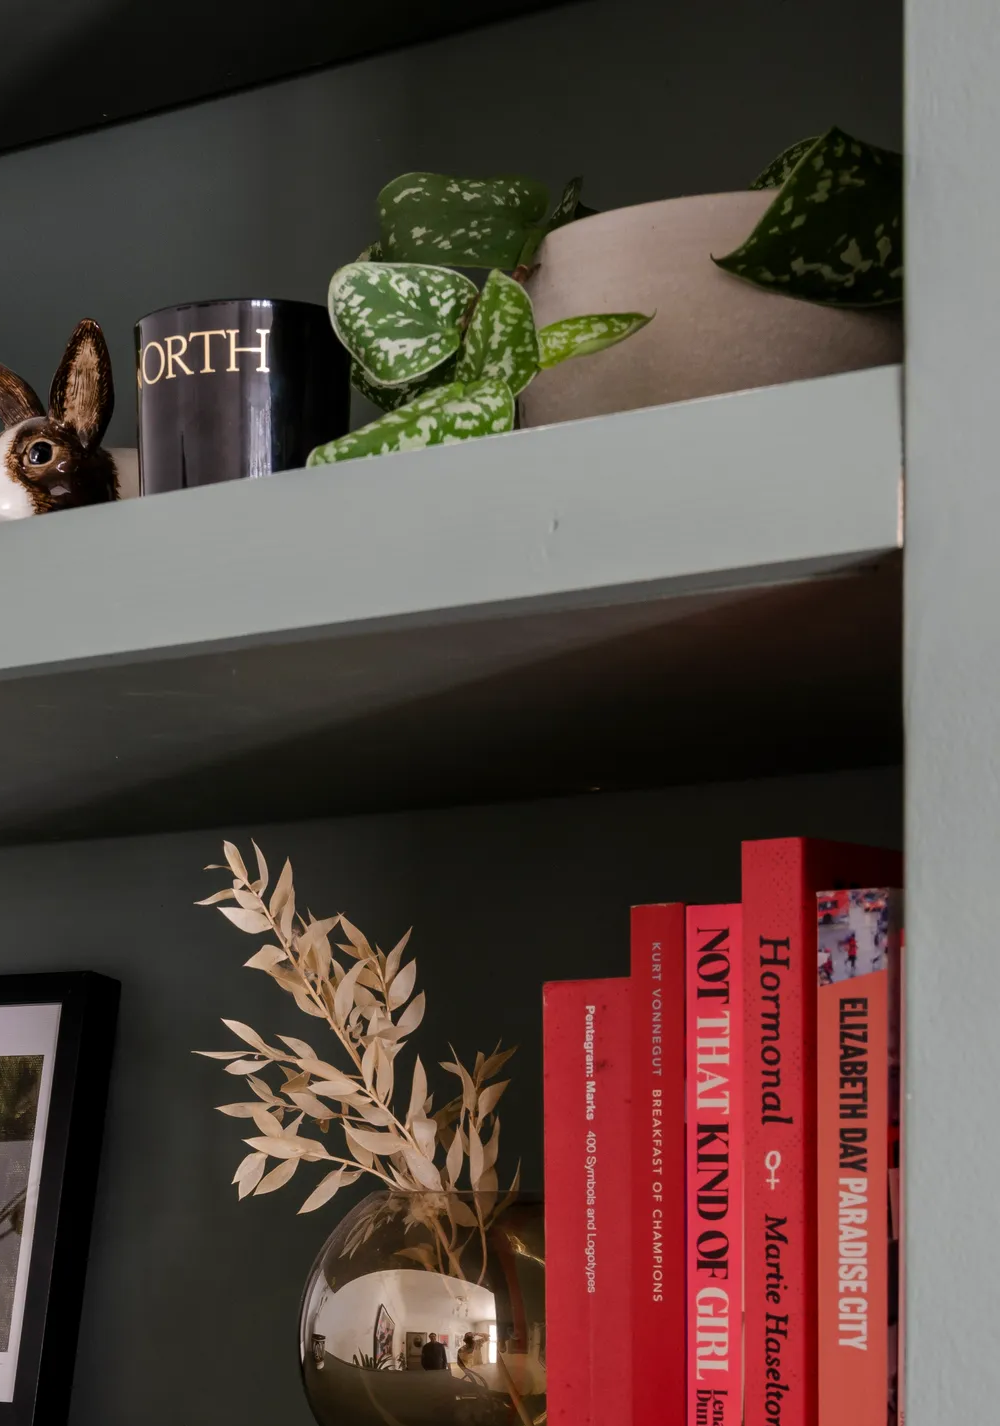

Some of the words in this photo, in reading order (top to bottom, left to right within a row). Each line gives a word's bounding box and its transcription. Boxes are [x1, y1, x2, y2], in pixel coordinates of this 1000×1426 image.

[651, 942, 663, 981] KURT
[696, 928, 729, 1004] NOT
[583, 1005, 595, 1078] Pentagram:
[651, 988, 663, 1076] VONNEGUT
[696, 1011, 729, 1114] THAT
[759, 935, 793, 1125] Hormonal
[839, 998, 868, 1119] ELIZABETH
[586, 1081, 595, 1120] Marks
[651, 1089, 663, 1175] BREAKFAST
[586, 1131, 595, 1153] 400
[697, 1123, 729, 1220] KIND
[839, 1128, 867, 1172] DAY
[585, 1156, 596, 1205] Symbols
[652, 1182, 663, 1203] OF
[587, 1208, 596, 1230] and
[652, 1210, 663, 1302] CHAMPIONS
[696, 1230, 729, 1279] OF
[838, 1177, 868, 1295] PARADISE
[584, 1234, 596, 1293] Logotypes
[764, 1214, 788, 1304] Martie
[696, 1287, 729, 1380] GIRL
[838, 1298, 868, 1350] CITY
